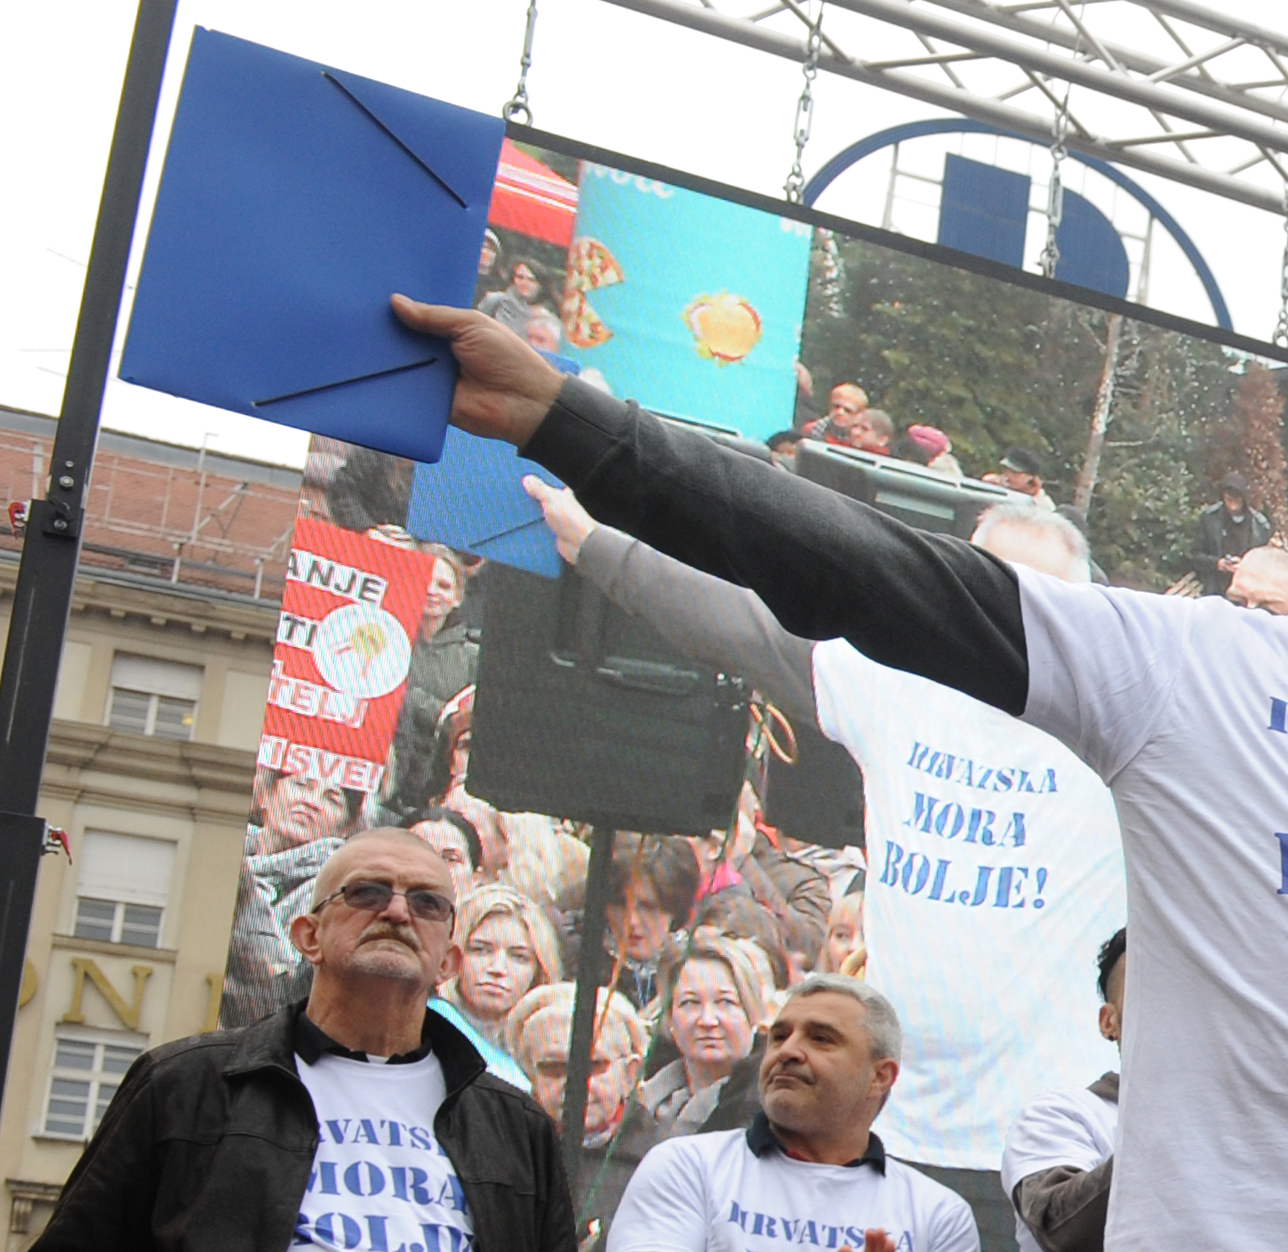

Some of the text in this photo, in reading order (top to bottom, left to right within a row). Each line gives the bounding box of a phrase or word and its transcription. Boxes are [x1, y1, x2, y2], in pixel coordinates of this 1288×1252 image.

[903, 790, 1027, 848] MORA
[878, 839, 1049, 910] BOLJE!
[318, 1118, 447, 1158] VATS
